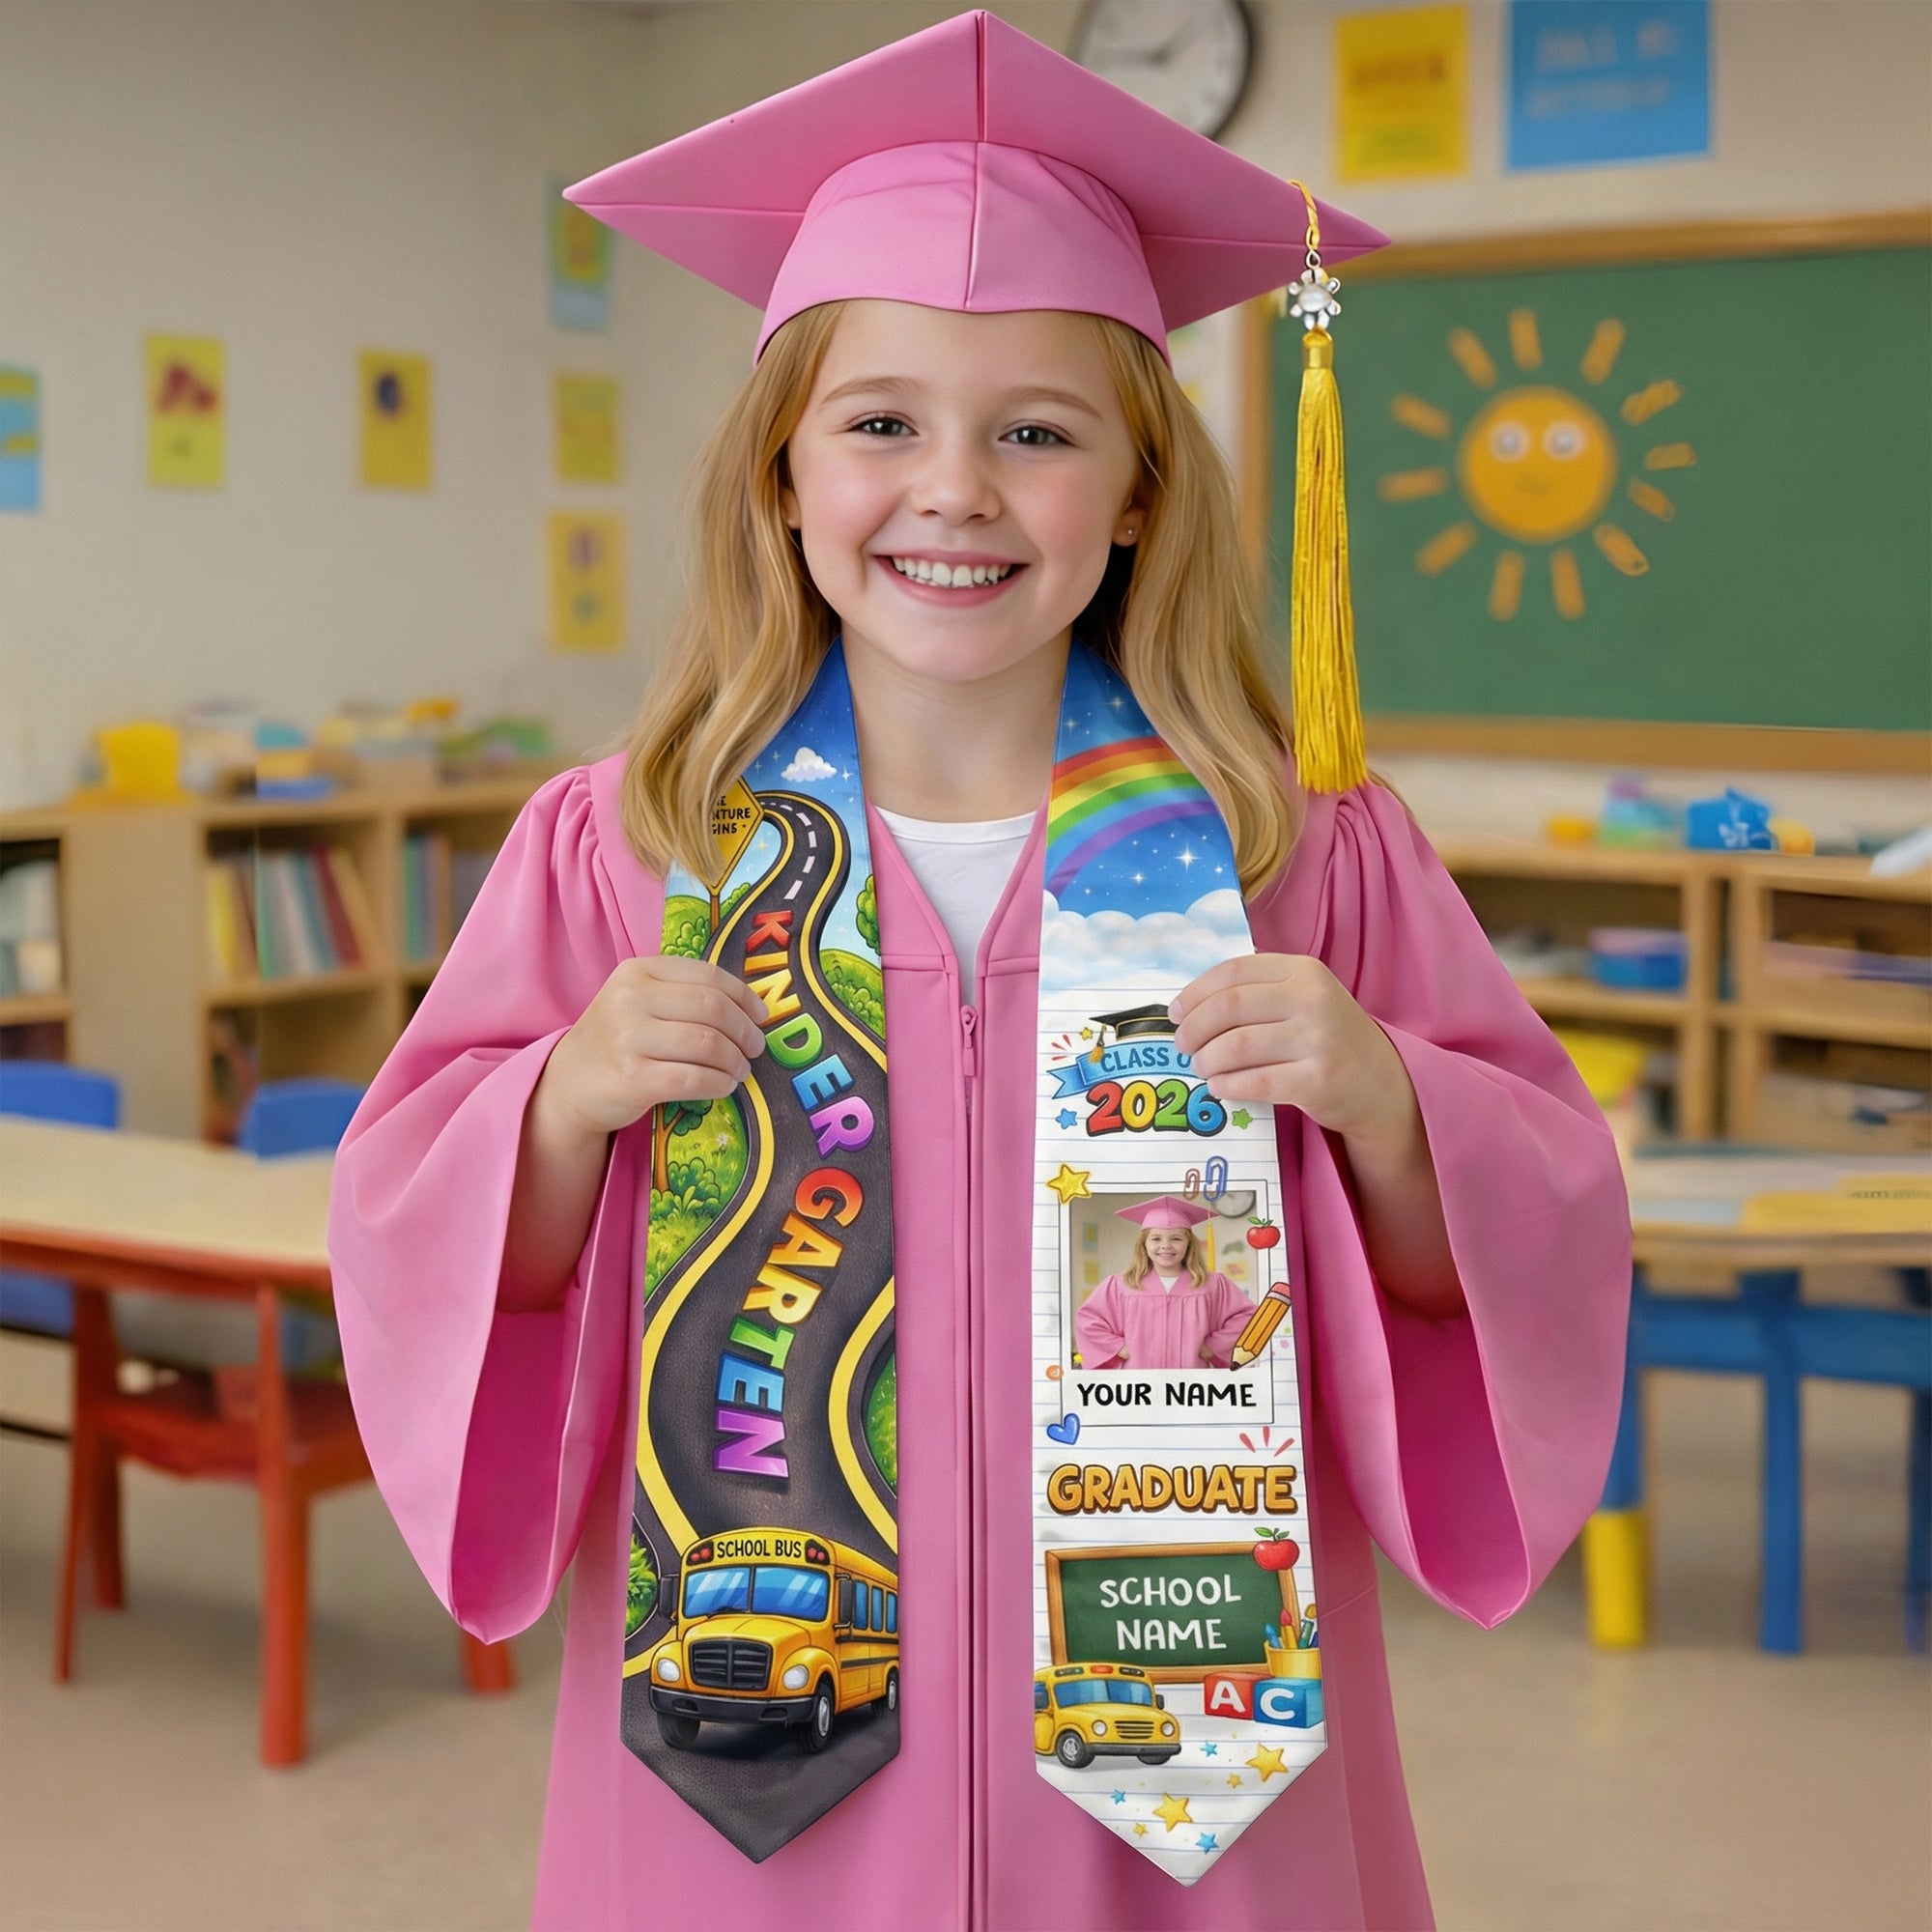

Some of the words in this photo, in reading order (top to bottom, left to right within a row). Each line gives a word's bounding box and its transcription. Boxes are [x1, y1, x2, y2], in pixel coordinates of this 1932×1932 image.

[712, 808, 751, 820] NTURE
[1100, 1047, 1170, 1072] CLASS
[1086, 1079, 1228, 1137] 2026
[1077, 1382, 1151, 1406] YOUR
[1165, 1381, 1257, 1407] NAME
[1047, 1463, 1298, 1515] GRADUATE
[717, 1540, 770, 1558] SCHOOL
[775, 1540, 802, 1558] BUS
[1099, 1575, 1241, 1607] SCHOOL
[1116, 1618, 1227, 1651] NAME
